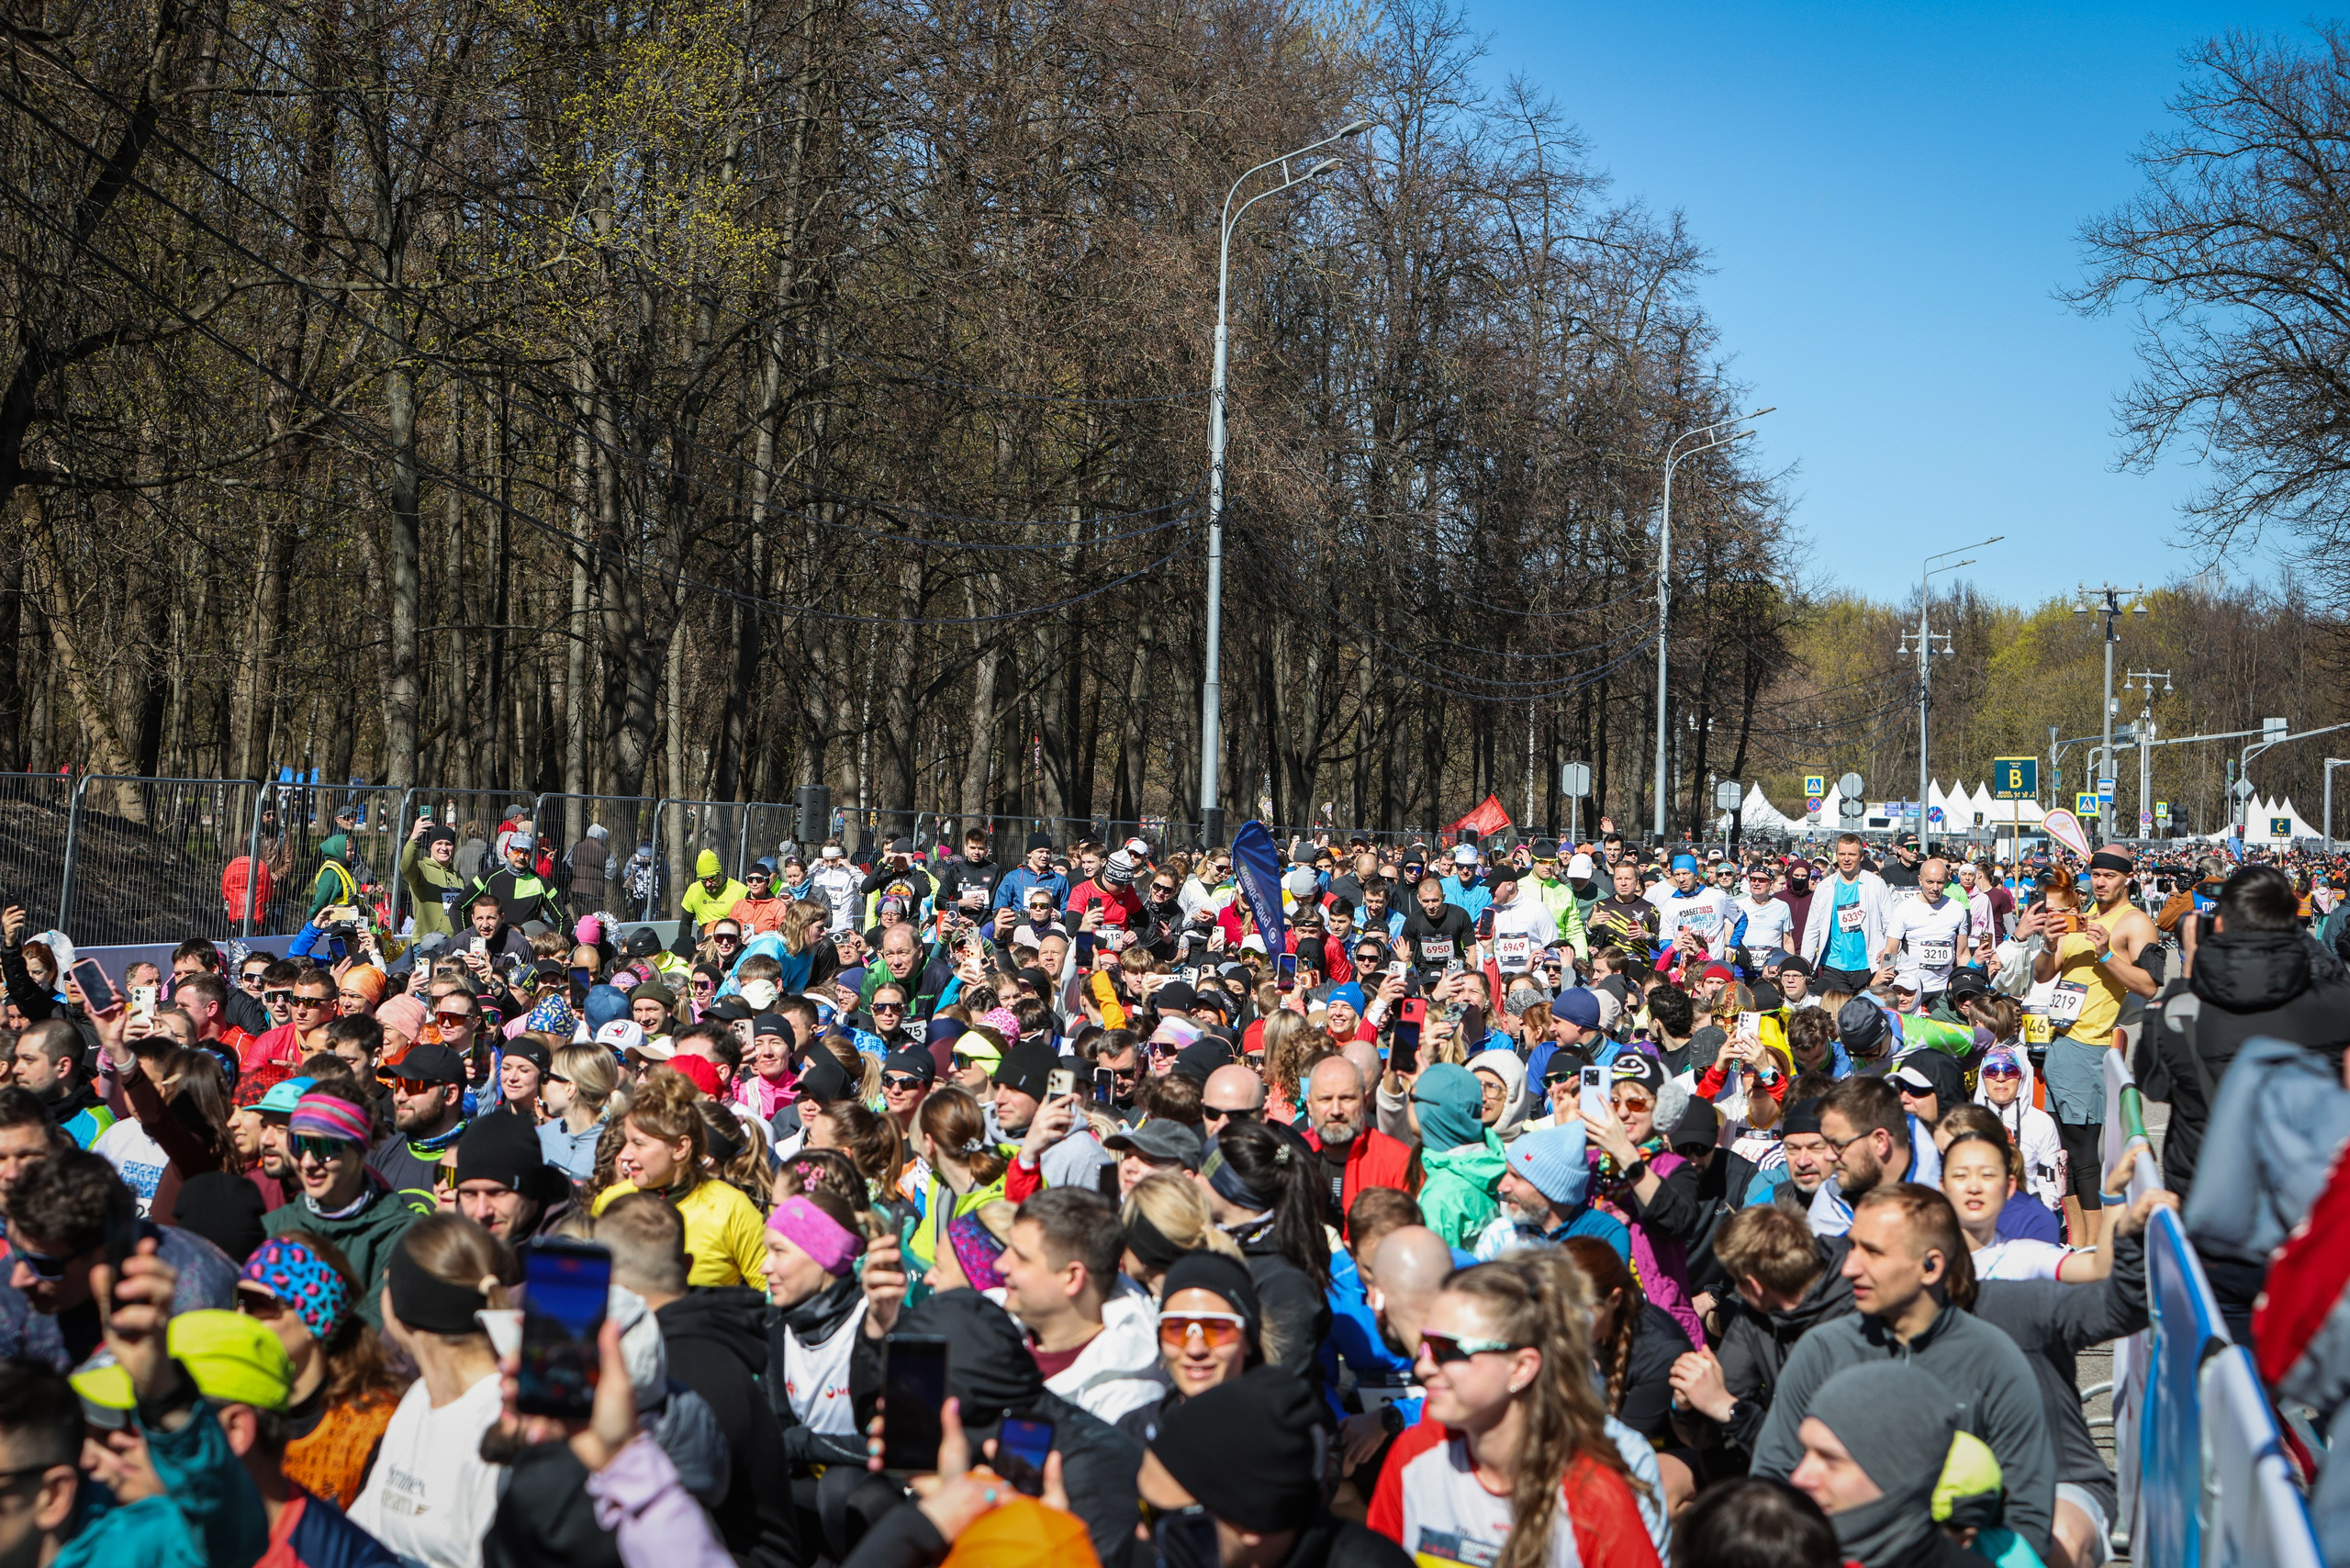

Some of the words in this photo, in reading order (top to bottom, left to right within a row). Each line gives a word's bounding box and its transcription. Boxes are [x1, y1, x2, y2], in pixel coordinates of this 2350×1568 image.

[2009, 769, 2022, 789] B
[2277, 822, 2285, 833] C
[2202, 902, 2219, 912] ПР
[1842, 910, 1863, 923] 6339
[1427, 945, 1449, 954] 6950
[1504, 942, 1525, 952] 6949
[1923, 949, 1948, 959] 3210
[2049, 993, 2076, 1010] 3219
